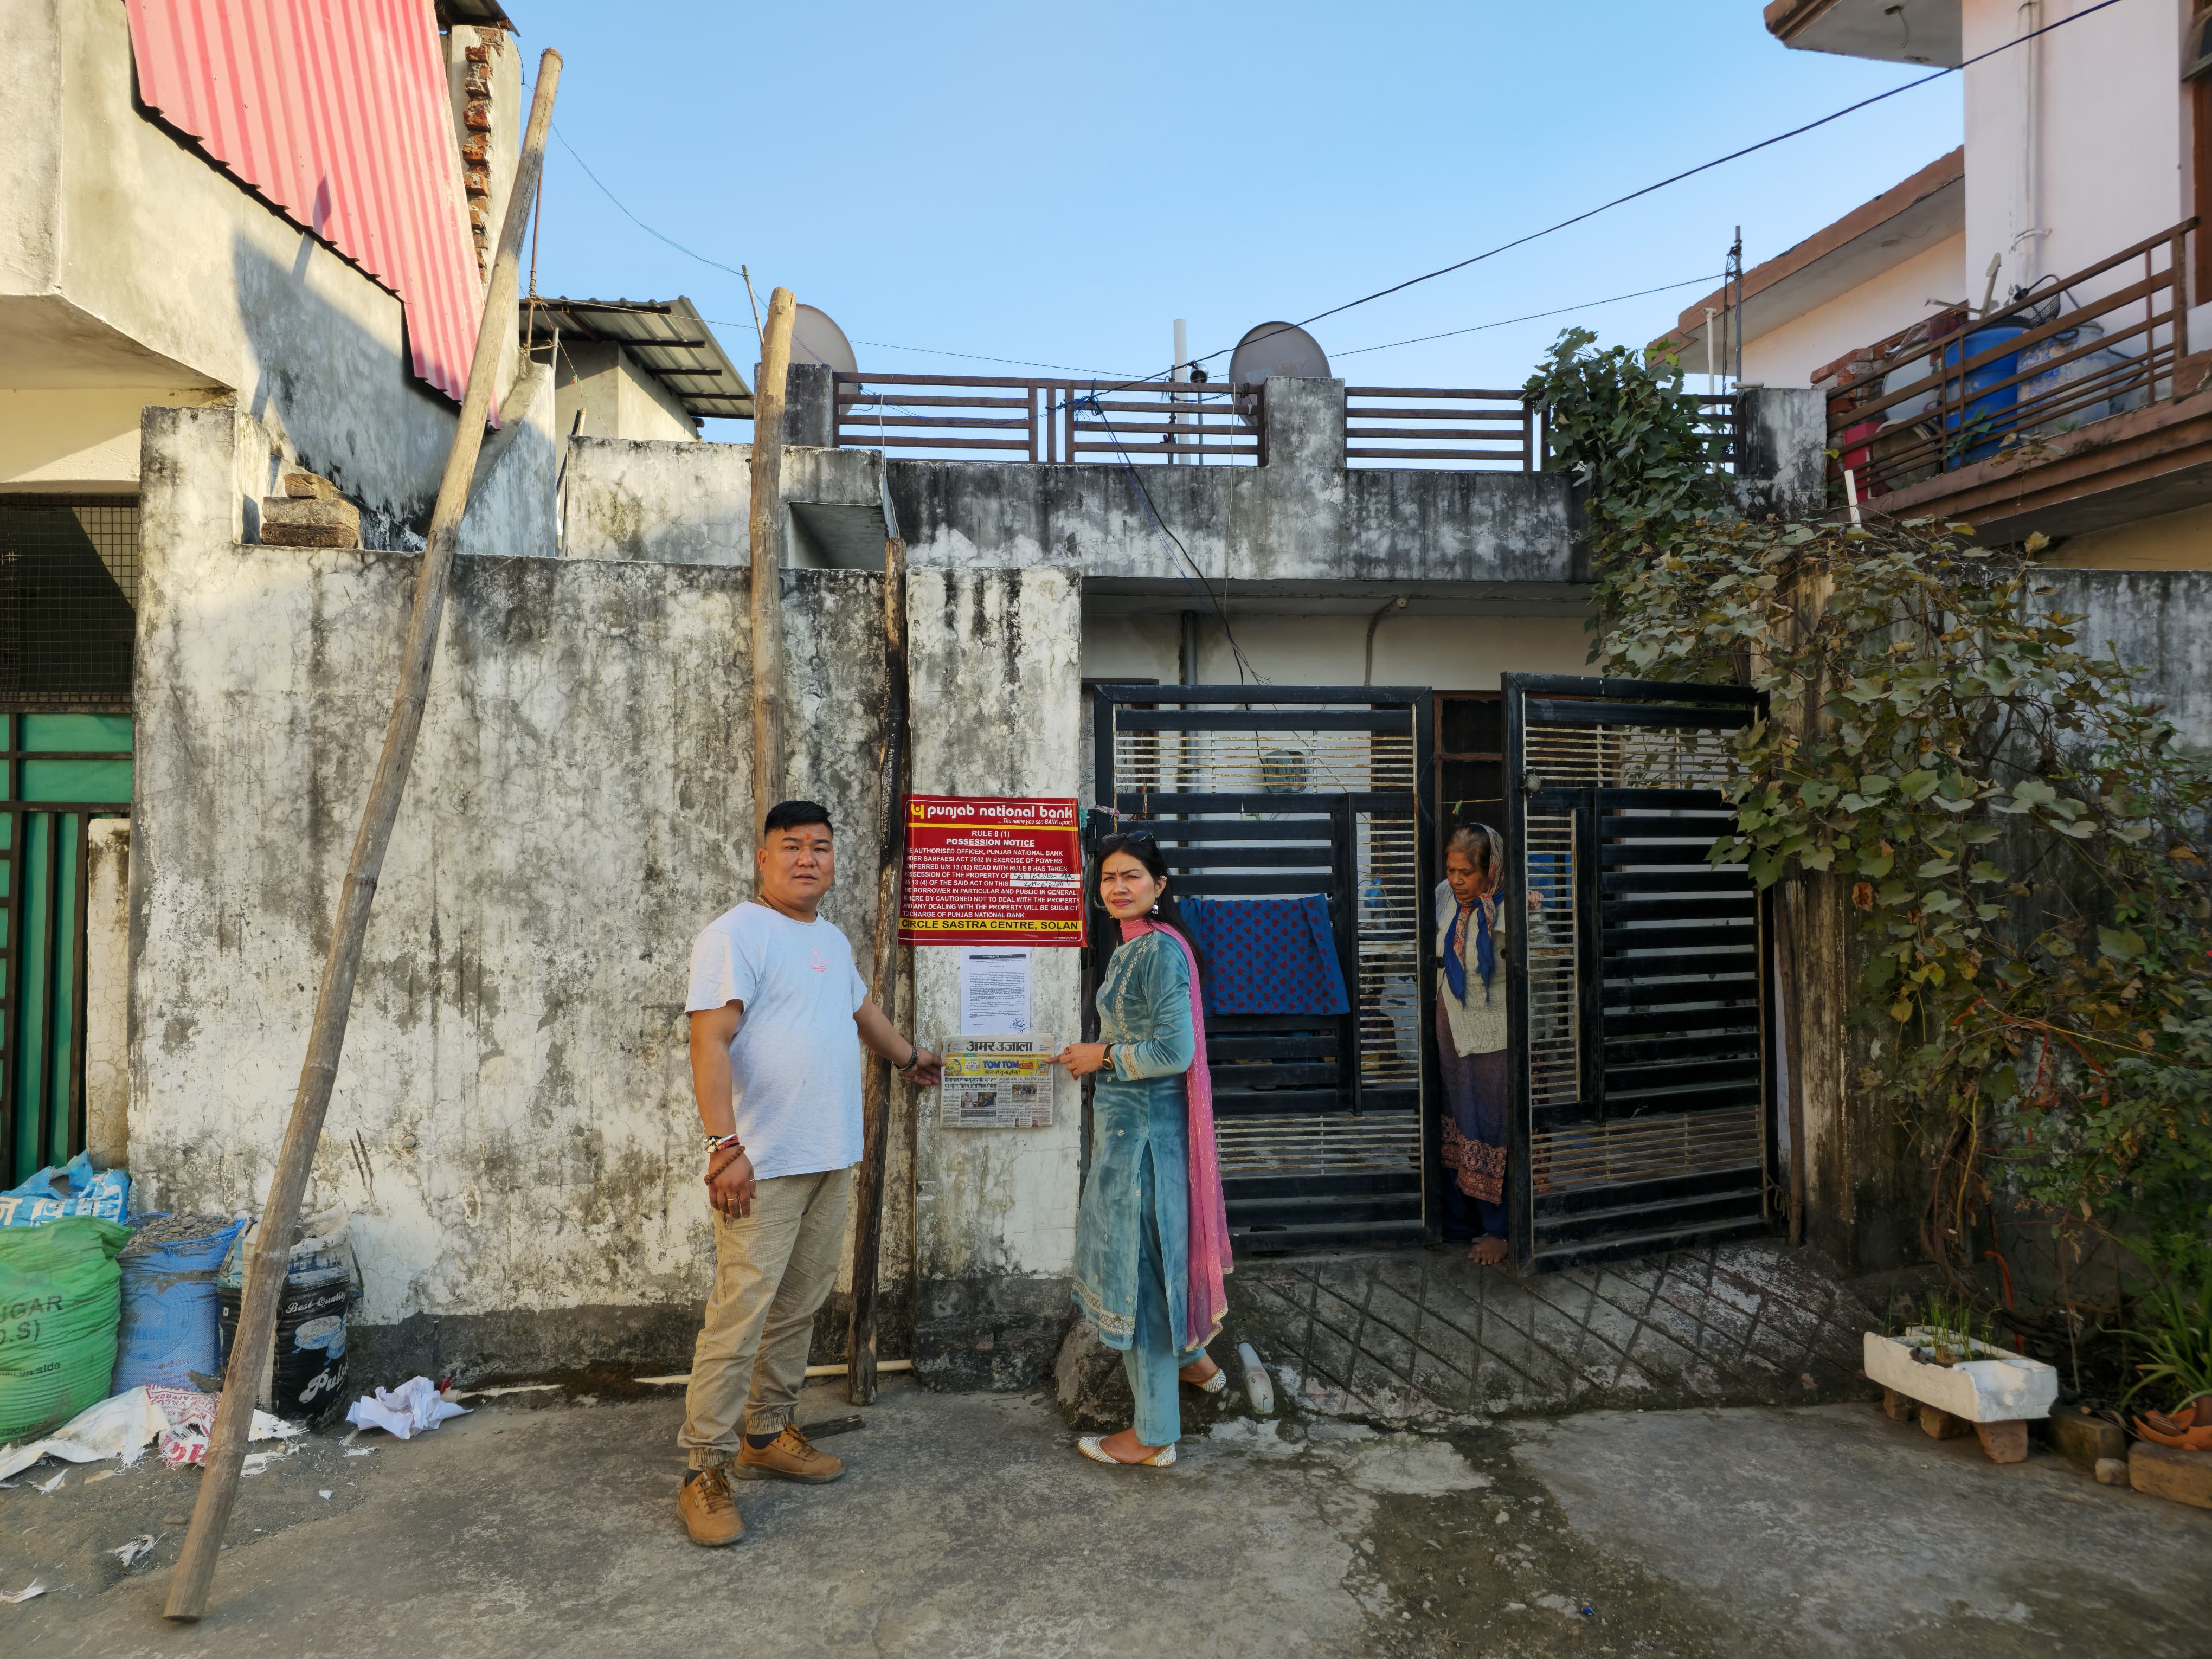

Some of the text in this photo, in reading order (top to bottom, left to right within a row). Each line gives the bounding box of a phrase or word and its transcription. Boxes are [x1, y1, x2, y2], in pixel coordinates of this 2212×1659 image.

[928, 804, 1072, 819] punjab national bank
[902, 919, 1078, 930] CIRCLE SASTRA CENTRE, SOLAN
[967, 1041, 995, 1052] अमर
[996, 1041, 1033, 1052] उजाला
[983, 1060, 1000, 1069] TOM
[1002, 1060, 1019, 1069] TOM
[285, 1291, 346, 1314] Best Quality
[36, 1361, 61, 1374] side
